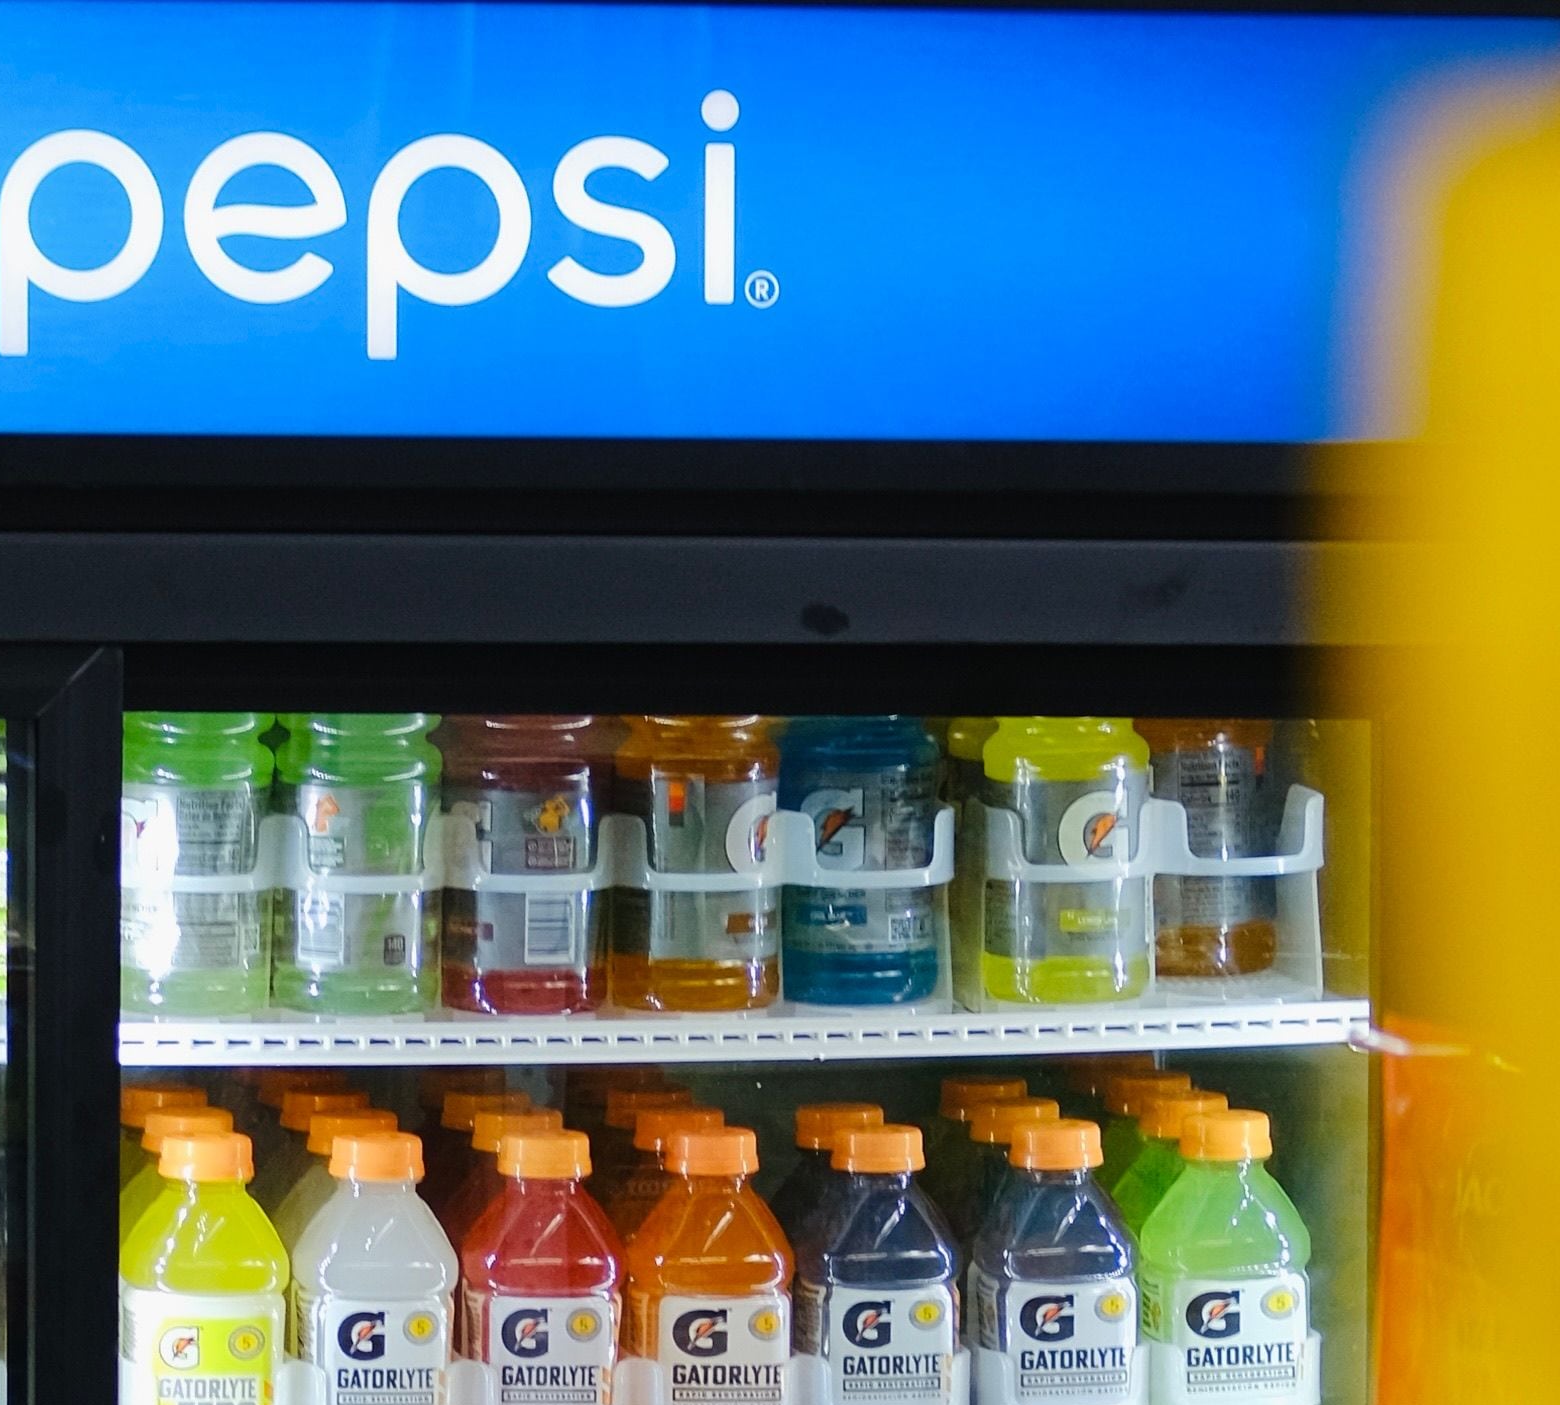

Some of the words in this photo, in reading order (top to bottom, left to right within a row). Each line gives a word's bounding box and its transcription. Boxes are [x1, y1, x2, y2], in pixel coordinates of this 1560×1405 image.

[842, 1301, 891, 1349] G
[1020, 1295, 1074, 1342] G
[1186, 1290, 1240, 1339] G
[159, 1326, 200, 1370] G
[337, 1311, 385, 1361] G
[501, 1308, 549, 1358] G
[673, 1309, 728, 1357] G
[843, 1355, 940, 1377] GATORLYTE
[1021, 1347, 1127, 1371] GATORLYTE
[1187, 1343, 1296, 1368] GATORLYTE
[158, 1377, 257, 1400] GATORLYTE
[337, 1368, 435, 1389] GATORLYTE
[502, 1365, 597, 1387] GATORLYTE
[673, 1364, 782, 1386] GATORLYTE
